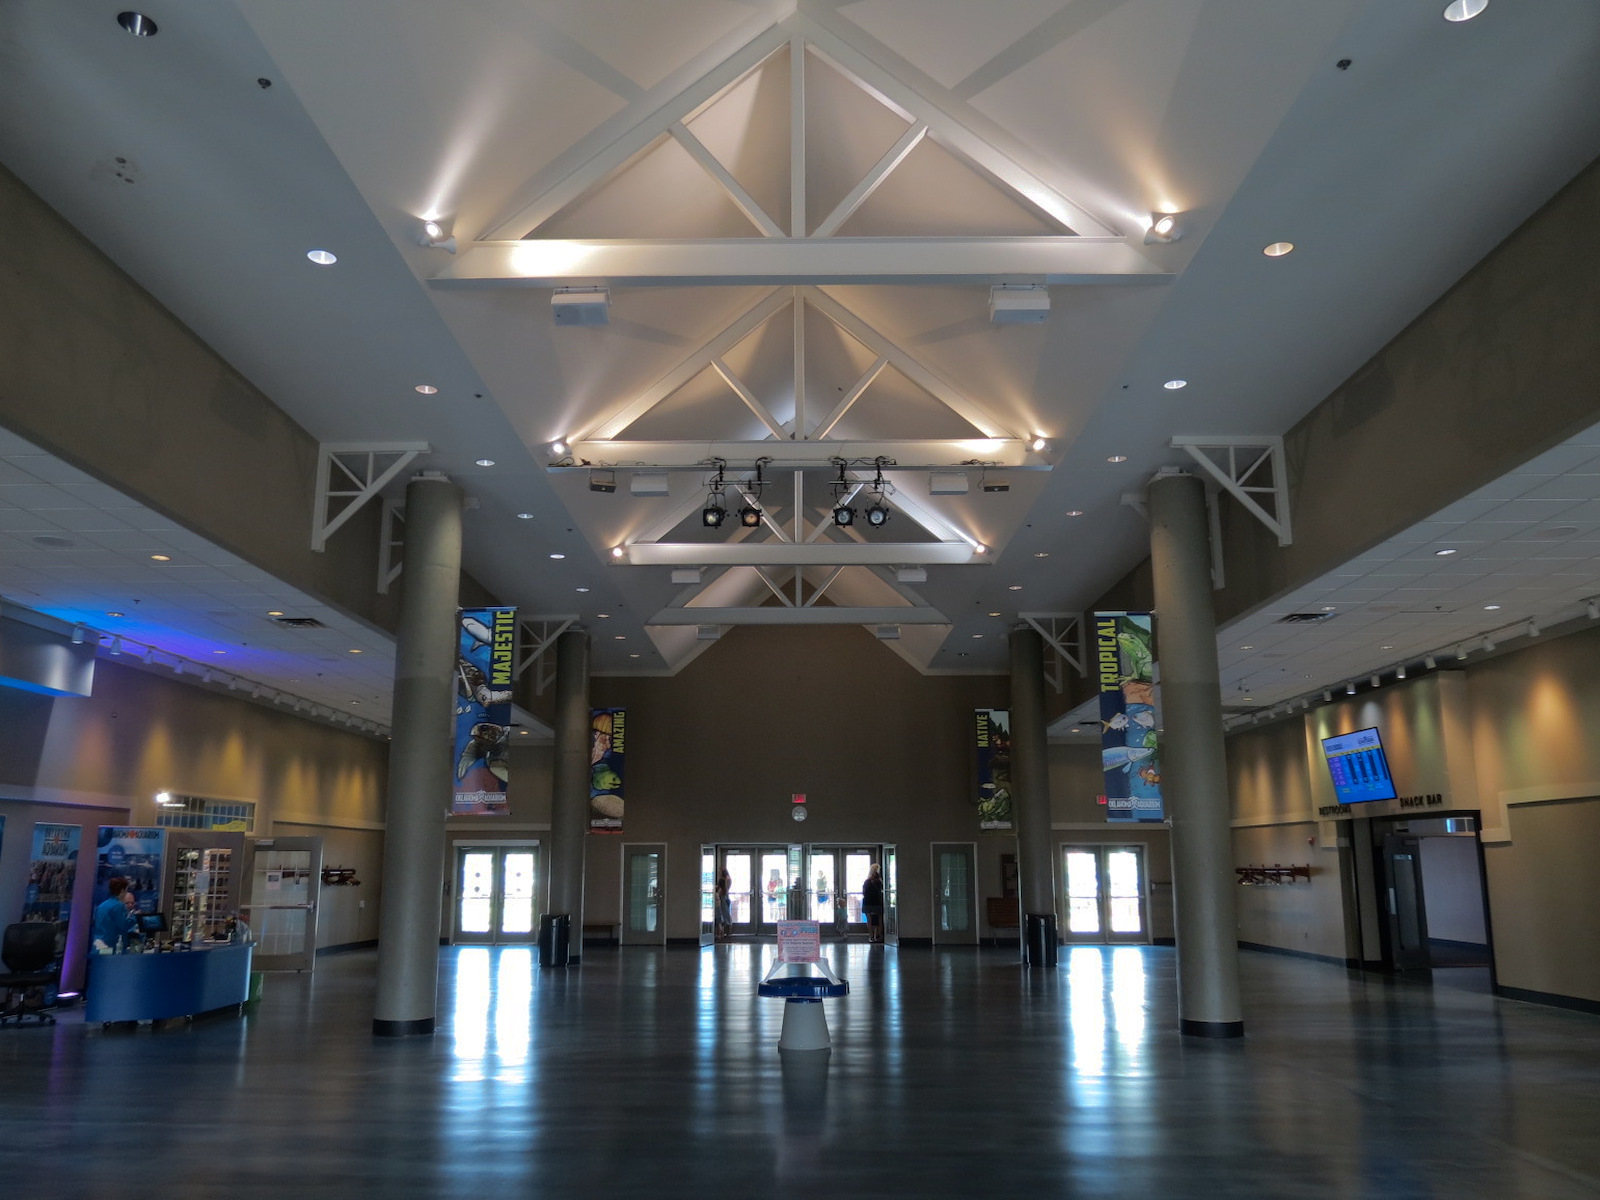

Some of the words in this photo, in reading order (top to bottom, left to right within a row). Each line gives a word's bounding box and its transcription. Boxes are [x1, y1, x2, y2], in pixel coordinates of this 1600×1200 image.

[492, 610, 514, 685] MAJESTIC
[1097, 619, 1120, 692] TROPICAL
[612, 711, 626, 754] AMAZING
[976, 714, 989, 748] NATIVE
[1400, 796, 1423, 807] SNACK
[1427, 794, 1442, 805] BAR
